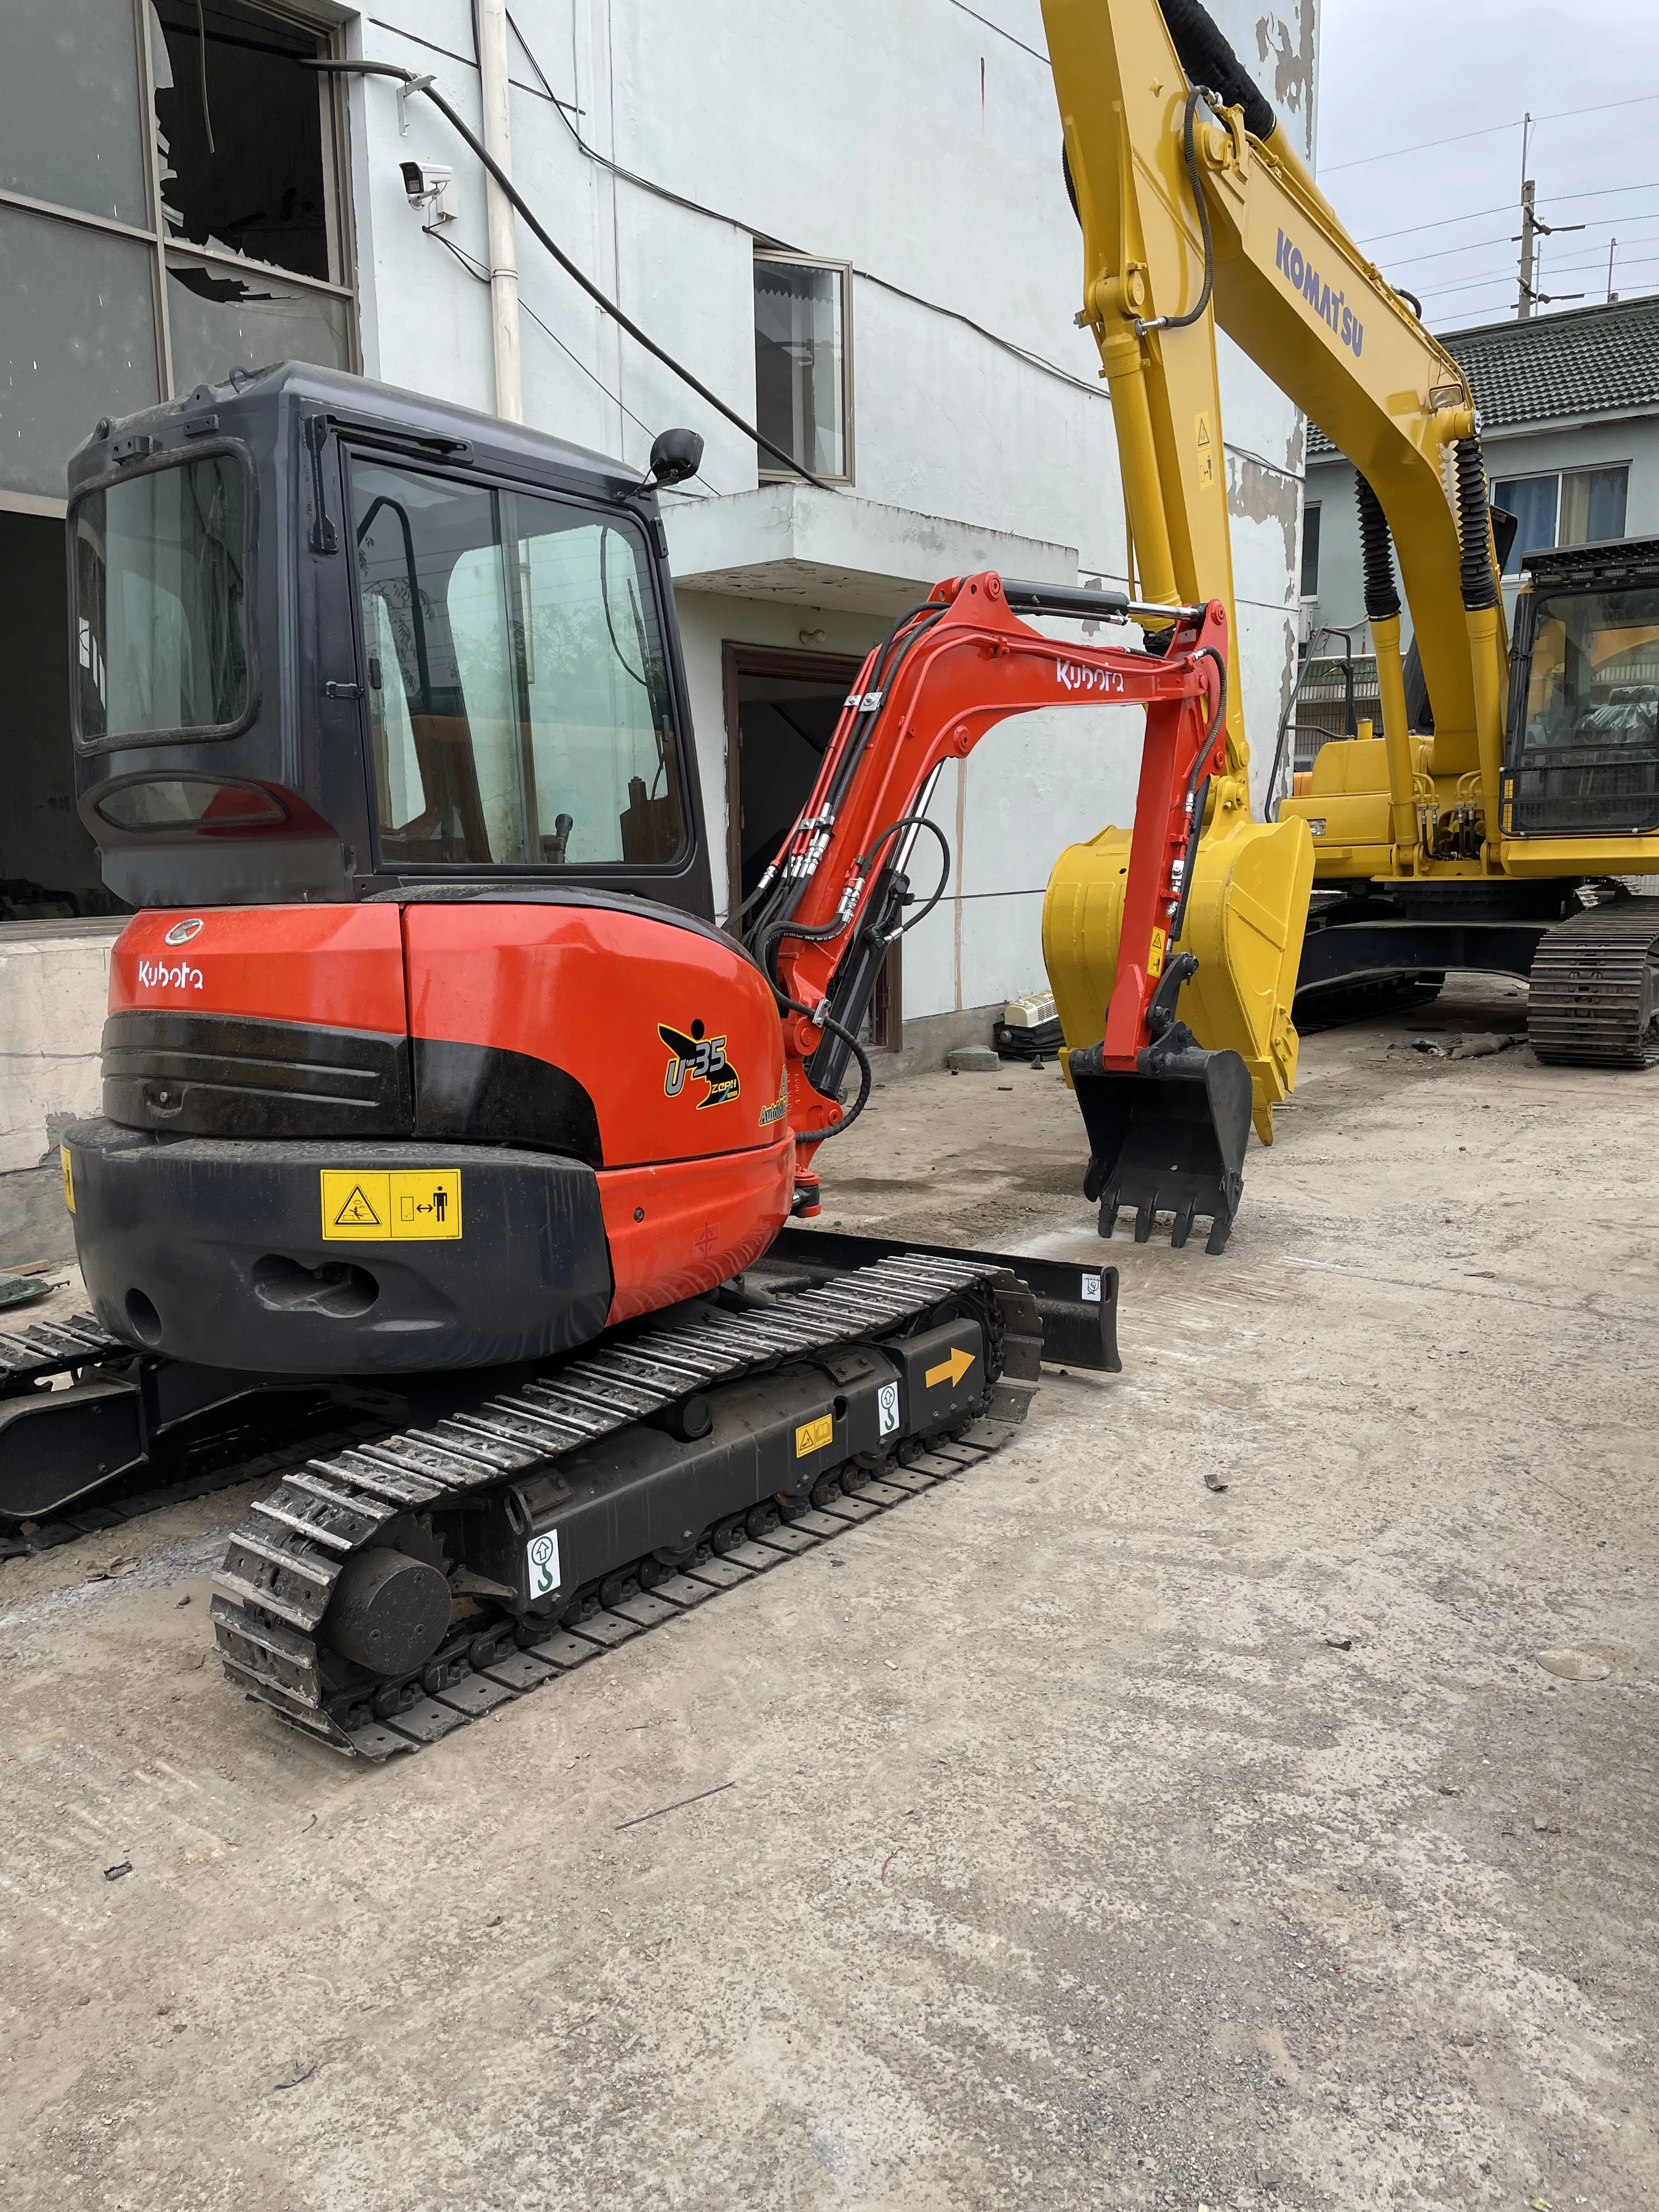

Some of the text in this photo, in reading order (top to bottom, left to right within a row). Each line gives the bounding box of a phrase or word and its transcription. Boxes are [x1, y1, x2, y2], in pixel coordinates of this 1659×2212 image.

[1276, 227, 1364, 358] KOMATSU
[1056, 657, 1125, 692] Kubota
[138, 961, 204, 989] Kubota
[665, 1038, 725, 1094] U-35
